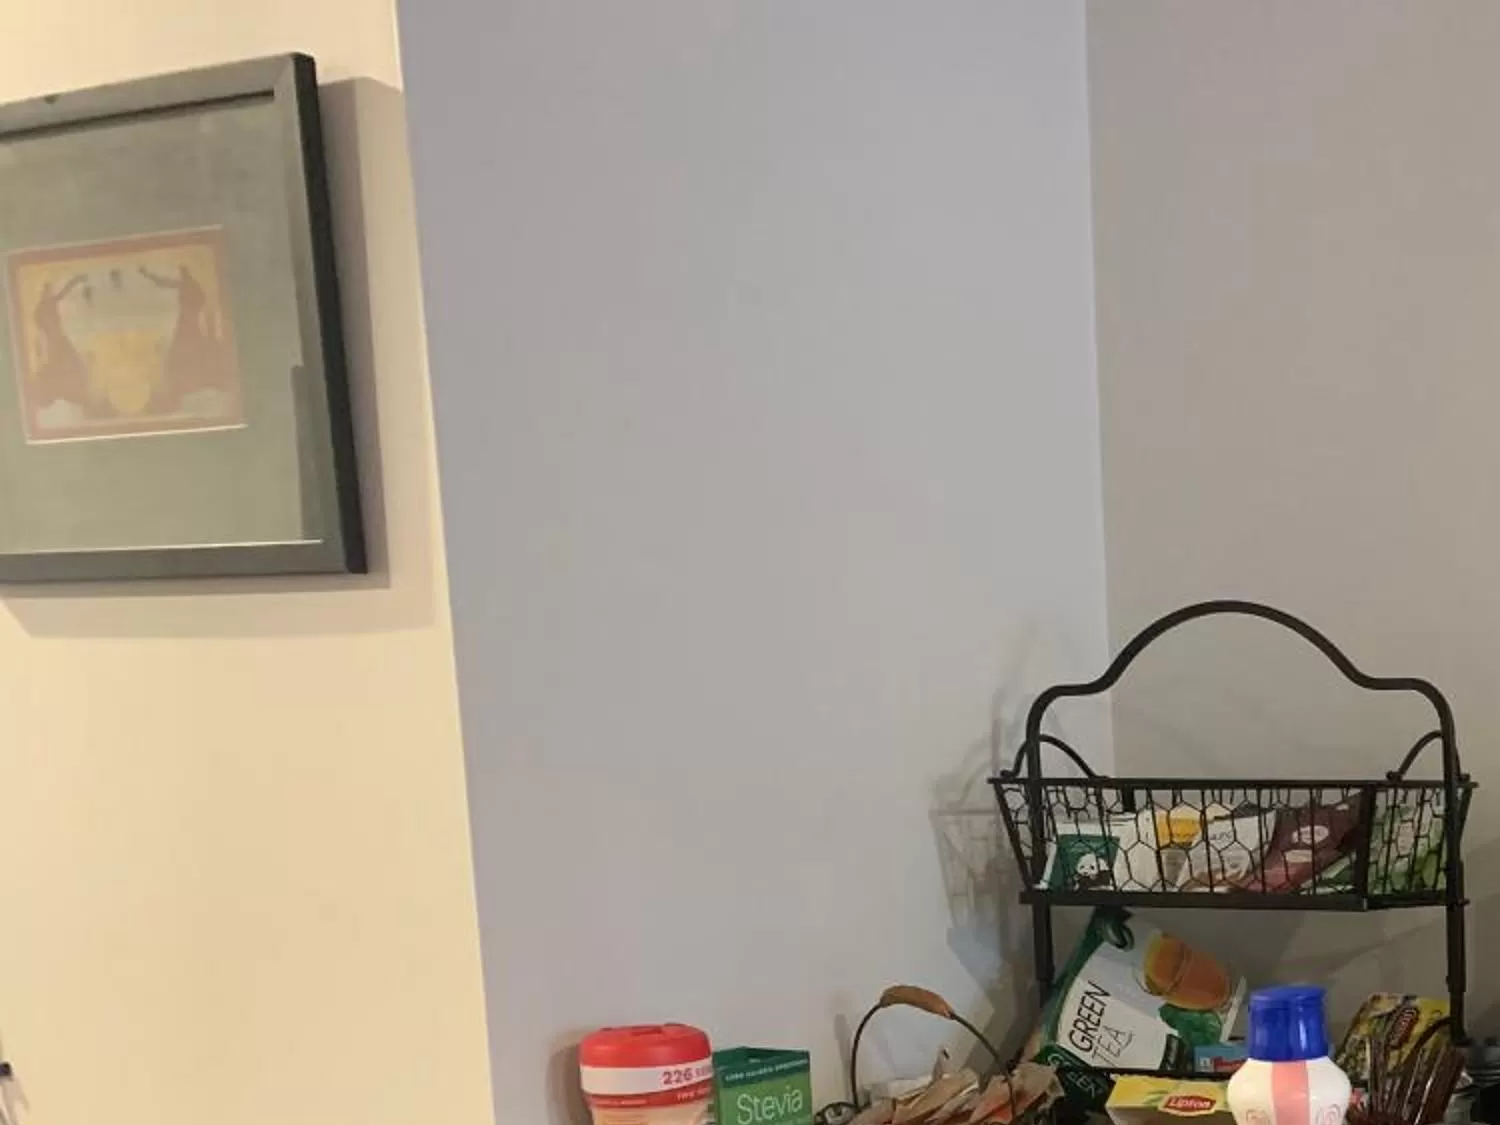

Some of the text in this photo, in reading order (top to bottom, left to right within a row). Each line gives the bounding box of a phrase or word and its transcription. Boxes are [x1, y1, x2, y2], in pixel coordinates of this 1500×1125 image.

[1069, 980, 1112, 1053] GREEN
[1090, 1024, 1134, 1069] TEA
[661, 1067, 693, 1085] 226
[736, 1085, 804, 1125] Stevia
[1168, 1095, 1211, 1109] Lipton
